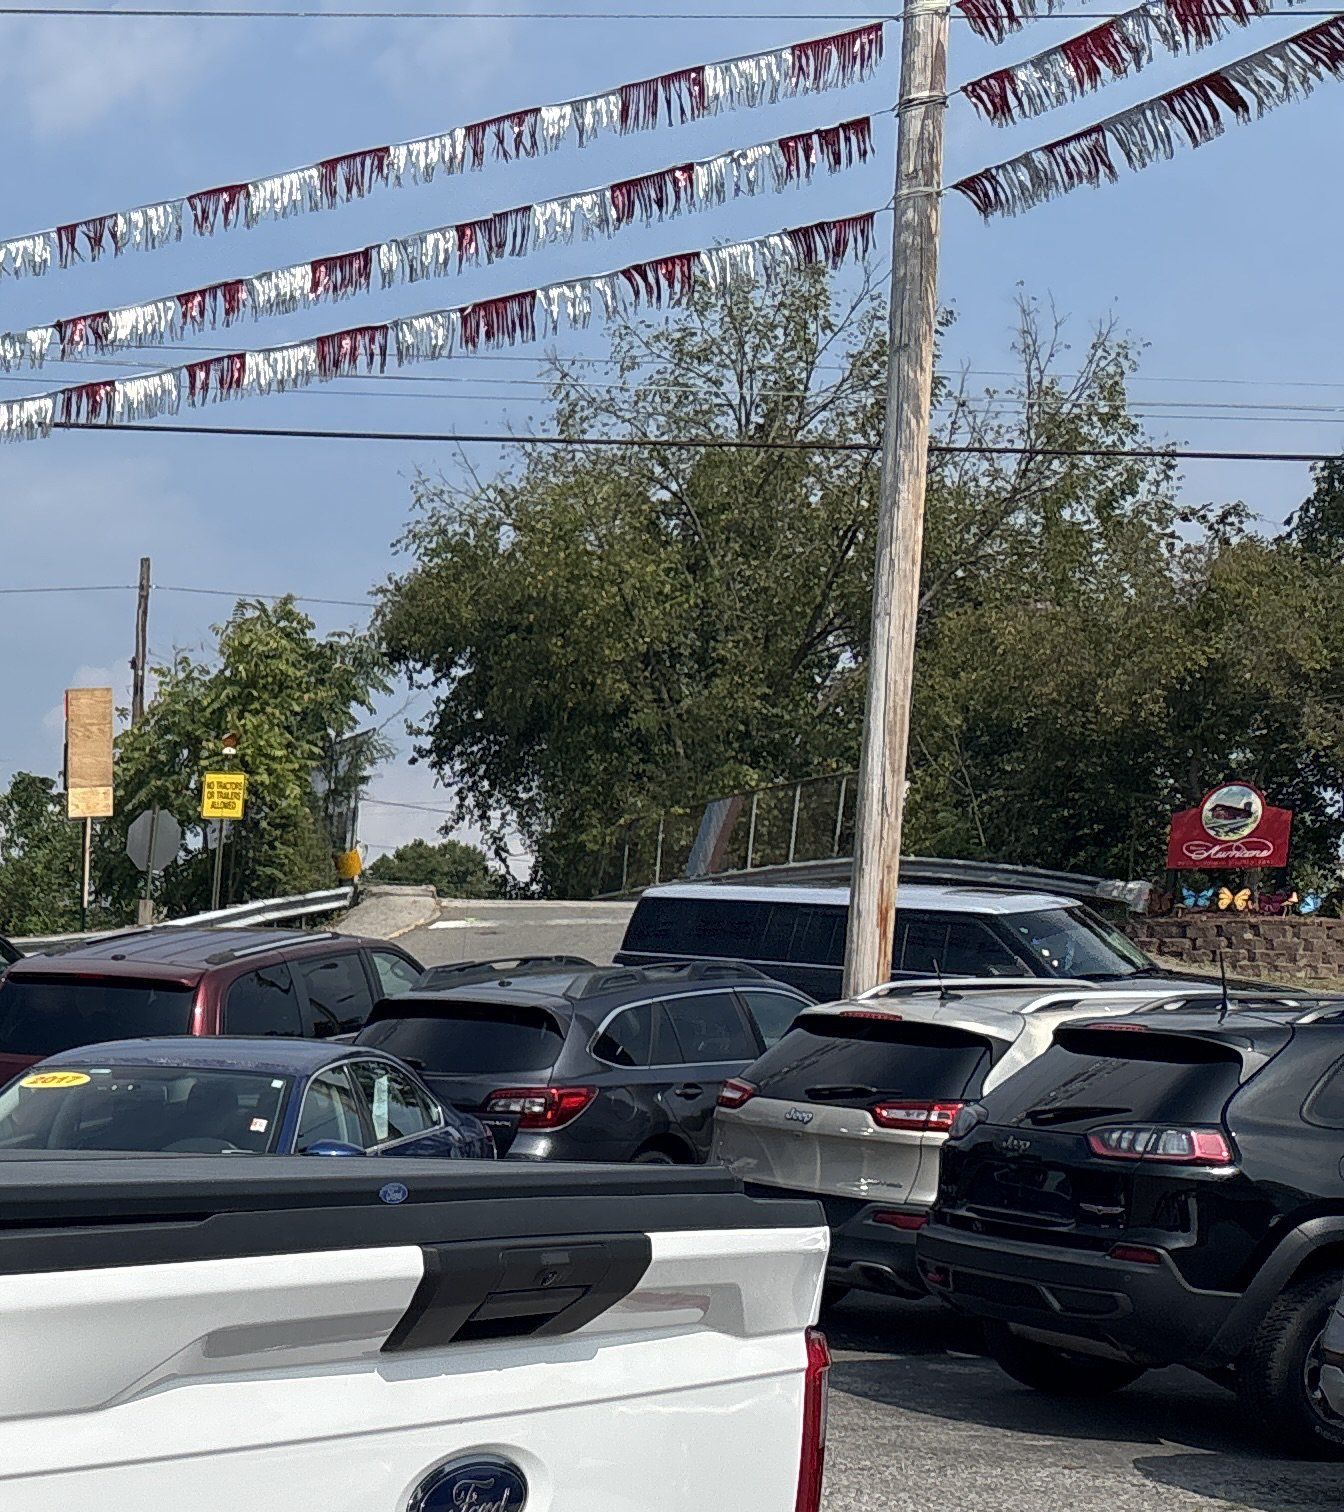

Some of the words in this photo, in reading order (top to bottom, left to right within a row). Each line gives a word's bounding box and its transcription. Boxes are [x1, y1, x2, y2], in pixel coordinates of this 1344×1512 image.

[26, 1075, 84, 1084] 2017
[785, 1107, 813, 1124] Jeep
[1002, 1135, 1031, 1150] Jeep
